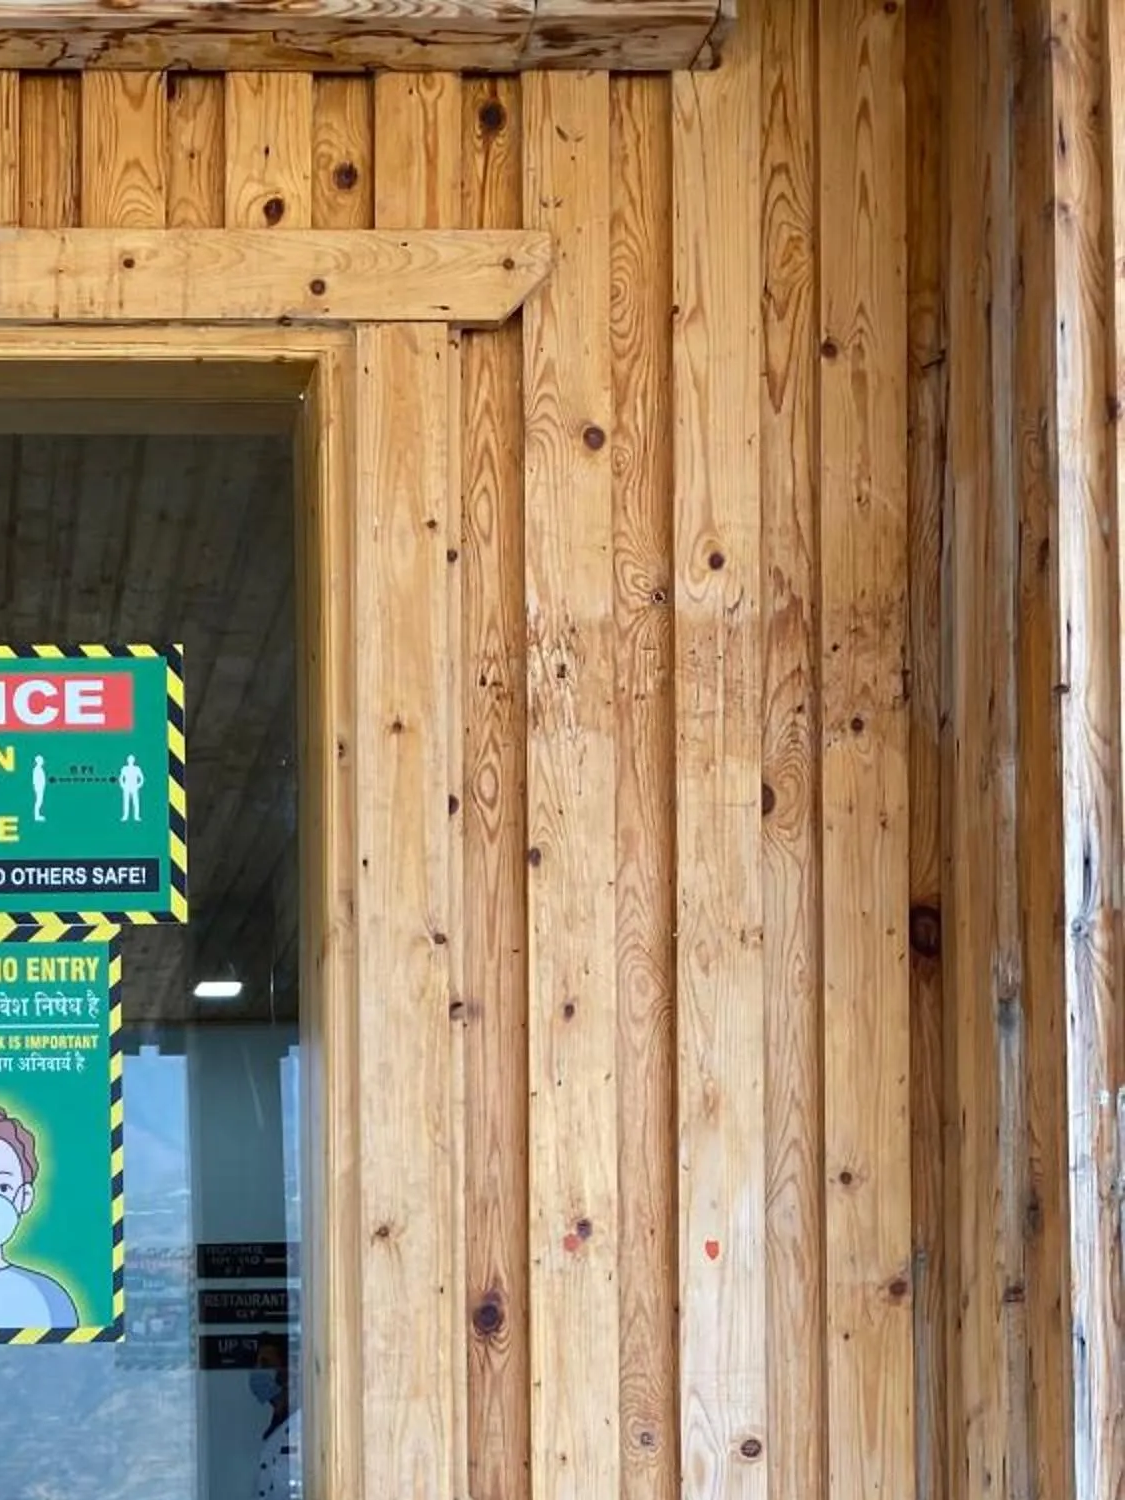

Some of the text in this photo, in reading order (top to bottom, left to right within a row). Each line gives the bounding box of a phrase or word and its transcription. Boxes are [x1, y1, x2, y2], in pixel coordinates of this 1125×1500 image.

[11, 867, 88, 885] OTHERS
[91, 867, 147, 885] SAFE!
[26, 956, 100, 983] ENTRY
[33, 990, 83, 1017] निषेध
[86, 988, 101, 1019] है
[8, 1035, 21, 1050] IS
[25, 1034, 99, 1050] IMPORTANT
[74, 1050, 86, 1073] है
